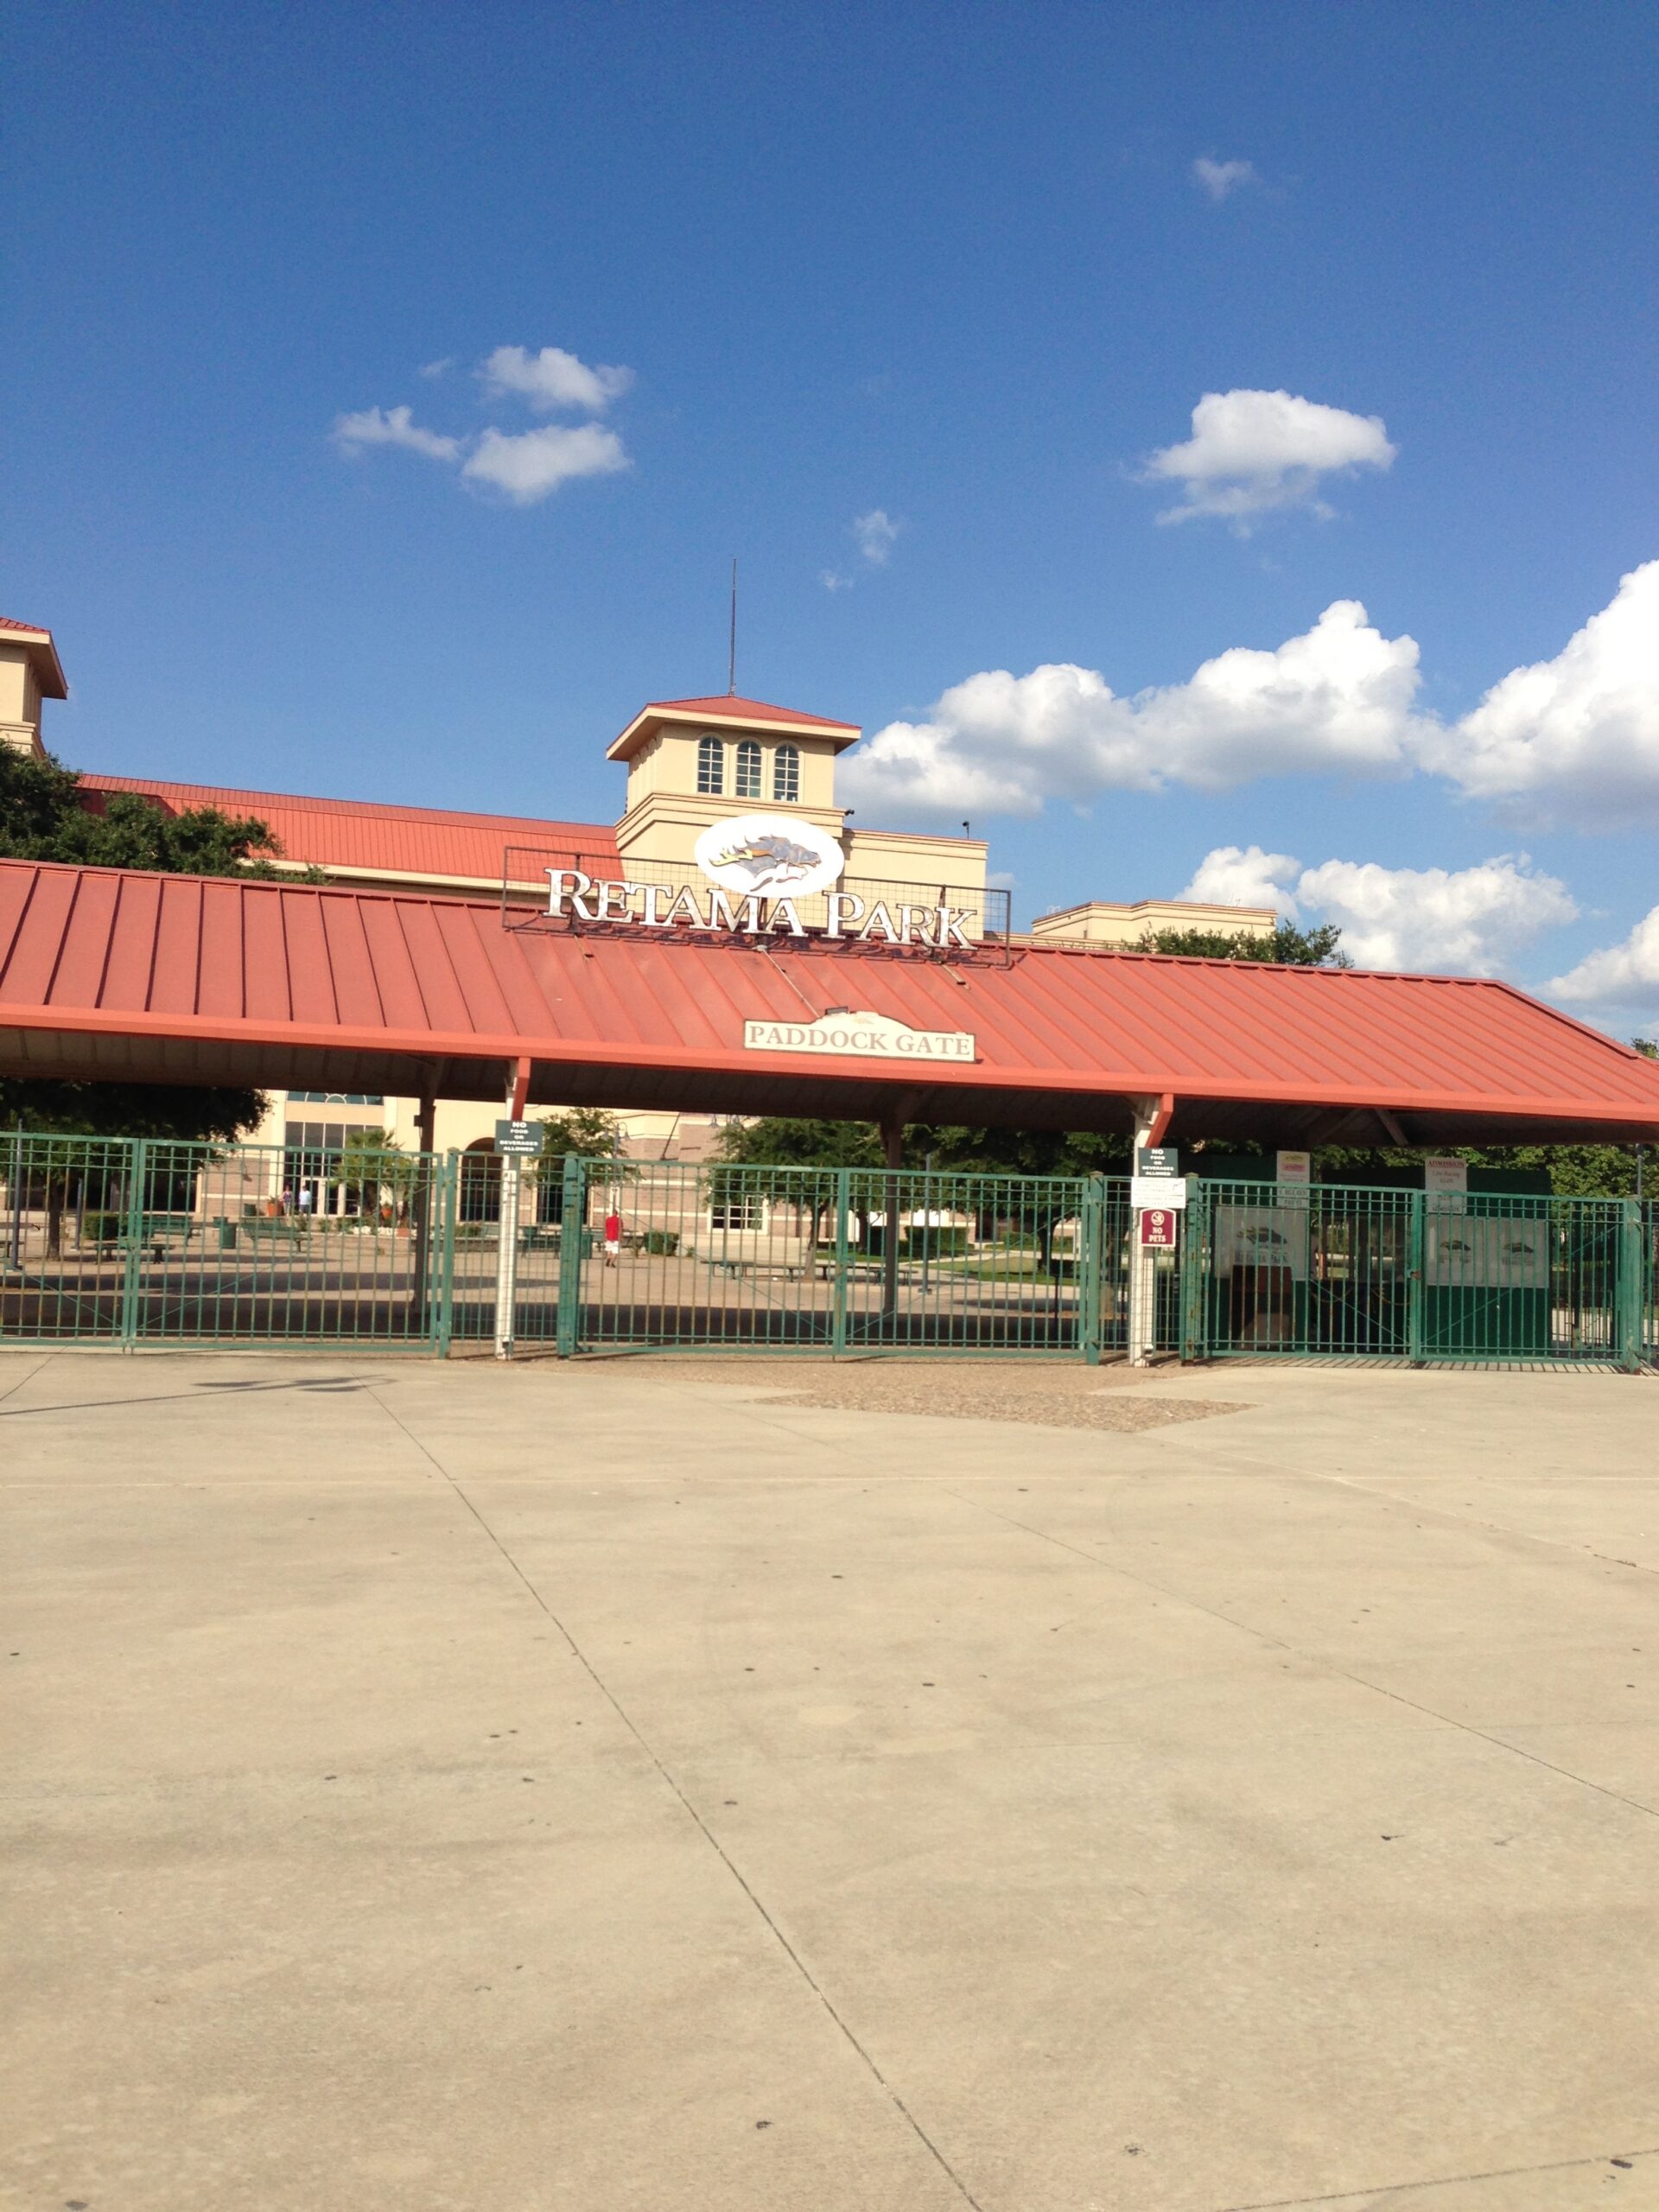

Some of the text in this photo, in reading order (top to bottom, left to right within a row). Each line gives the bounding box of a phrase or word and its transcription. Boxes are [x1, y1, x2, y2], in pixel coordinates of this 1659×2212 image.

[543, 868, 979, 950] RETAMA PARK
[749, 1026, 970, 1055] PADDOCK GATE
